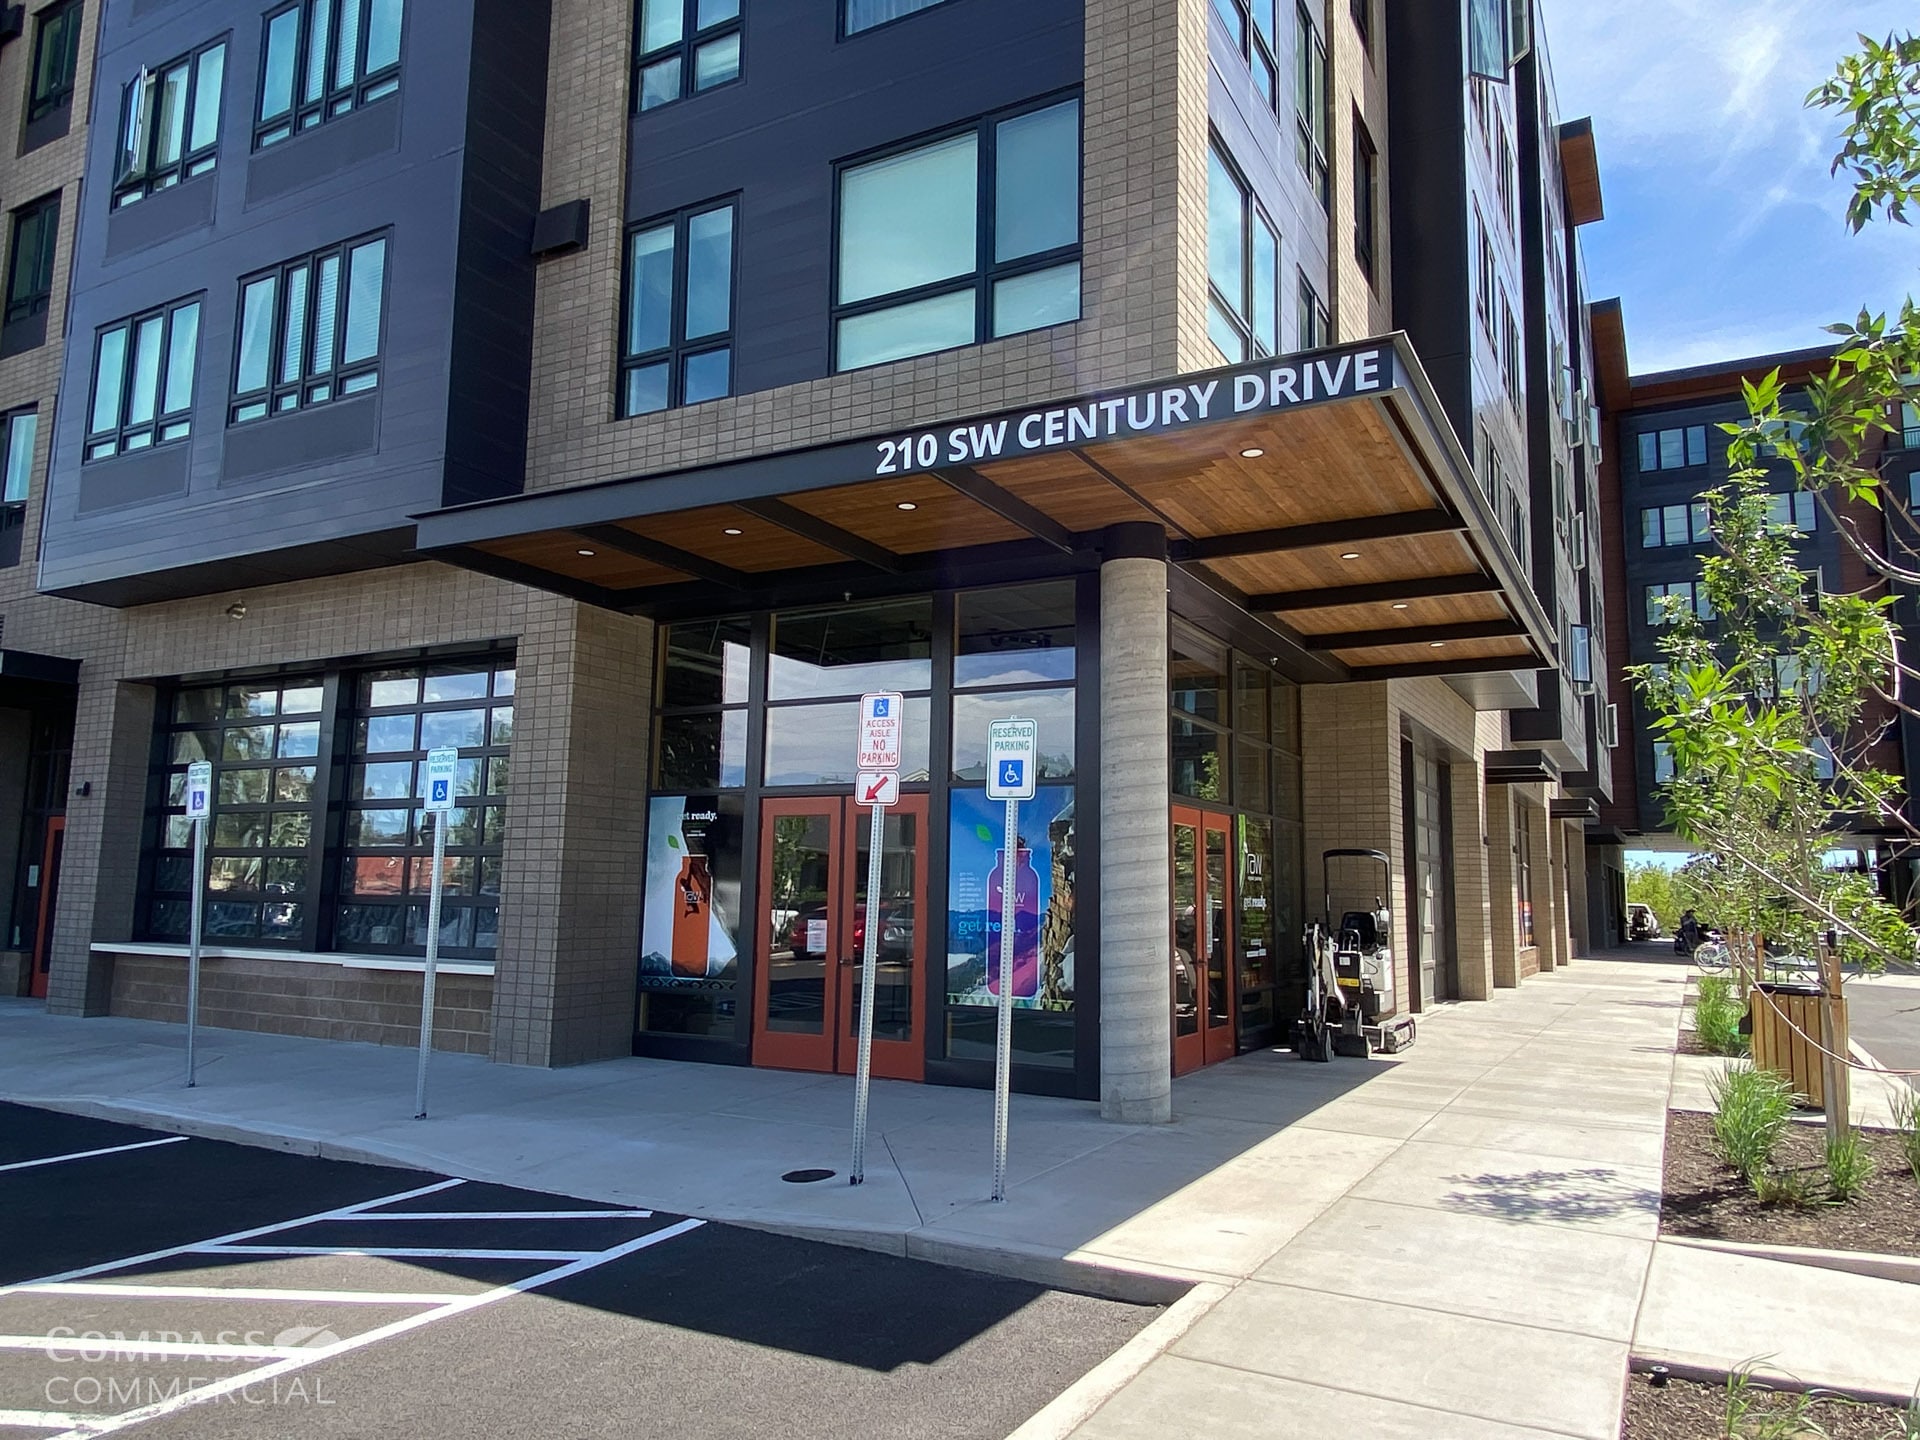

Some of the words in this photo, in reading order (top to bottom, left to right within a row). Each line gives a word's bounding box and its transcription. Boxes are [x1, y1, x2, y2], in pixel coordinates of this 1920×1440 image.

[876, 433, 938, 474] 210
[948, 420, 1008, 462] SW
[1018, 380, 1219, 449] CENTURY
[1234, 350, 1379, 412] DRIVE
[866, 719, 895, 728] ACCESS
[869, 729, 891, 738] AISLE
[992, 727, 1032, 738] RESERVED
[872, 739, 886, 751] NO
[994, 740, 1030, 751] PARKING
[861, 752, 897, 764] PARKING
[691, 810, 718, 822] ready.
[958, 919, 982, 935] get
